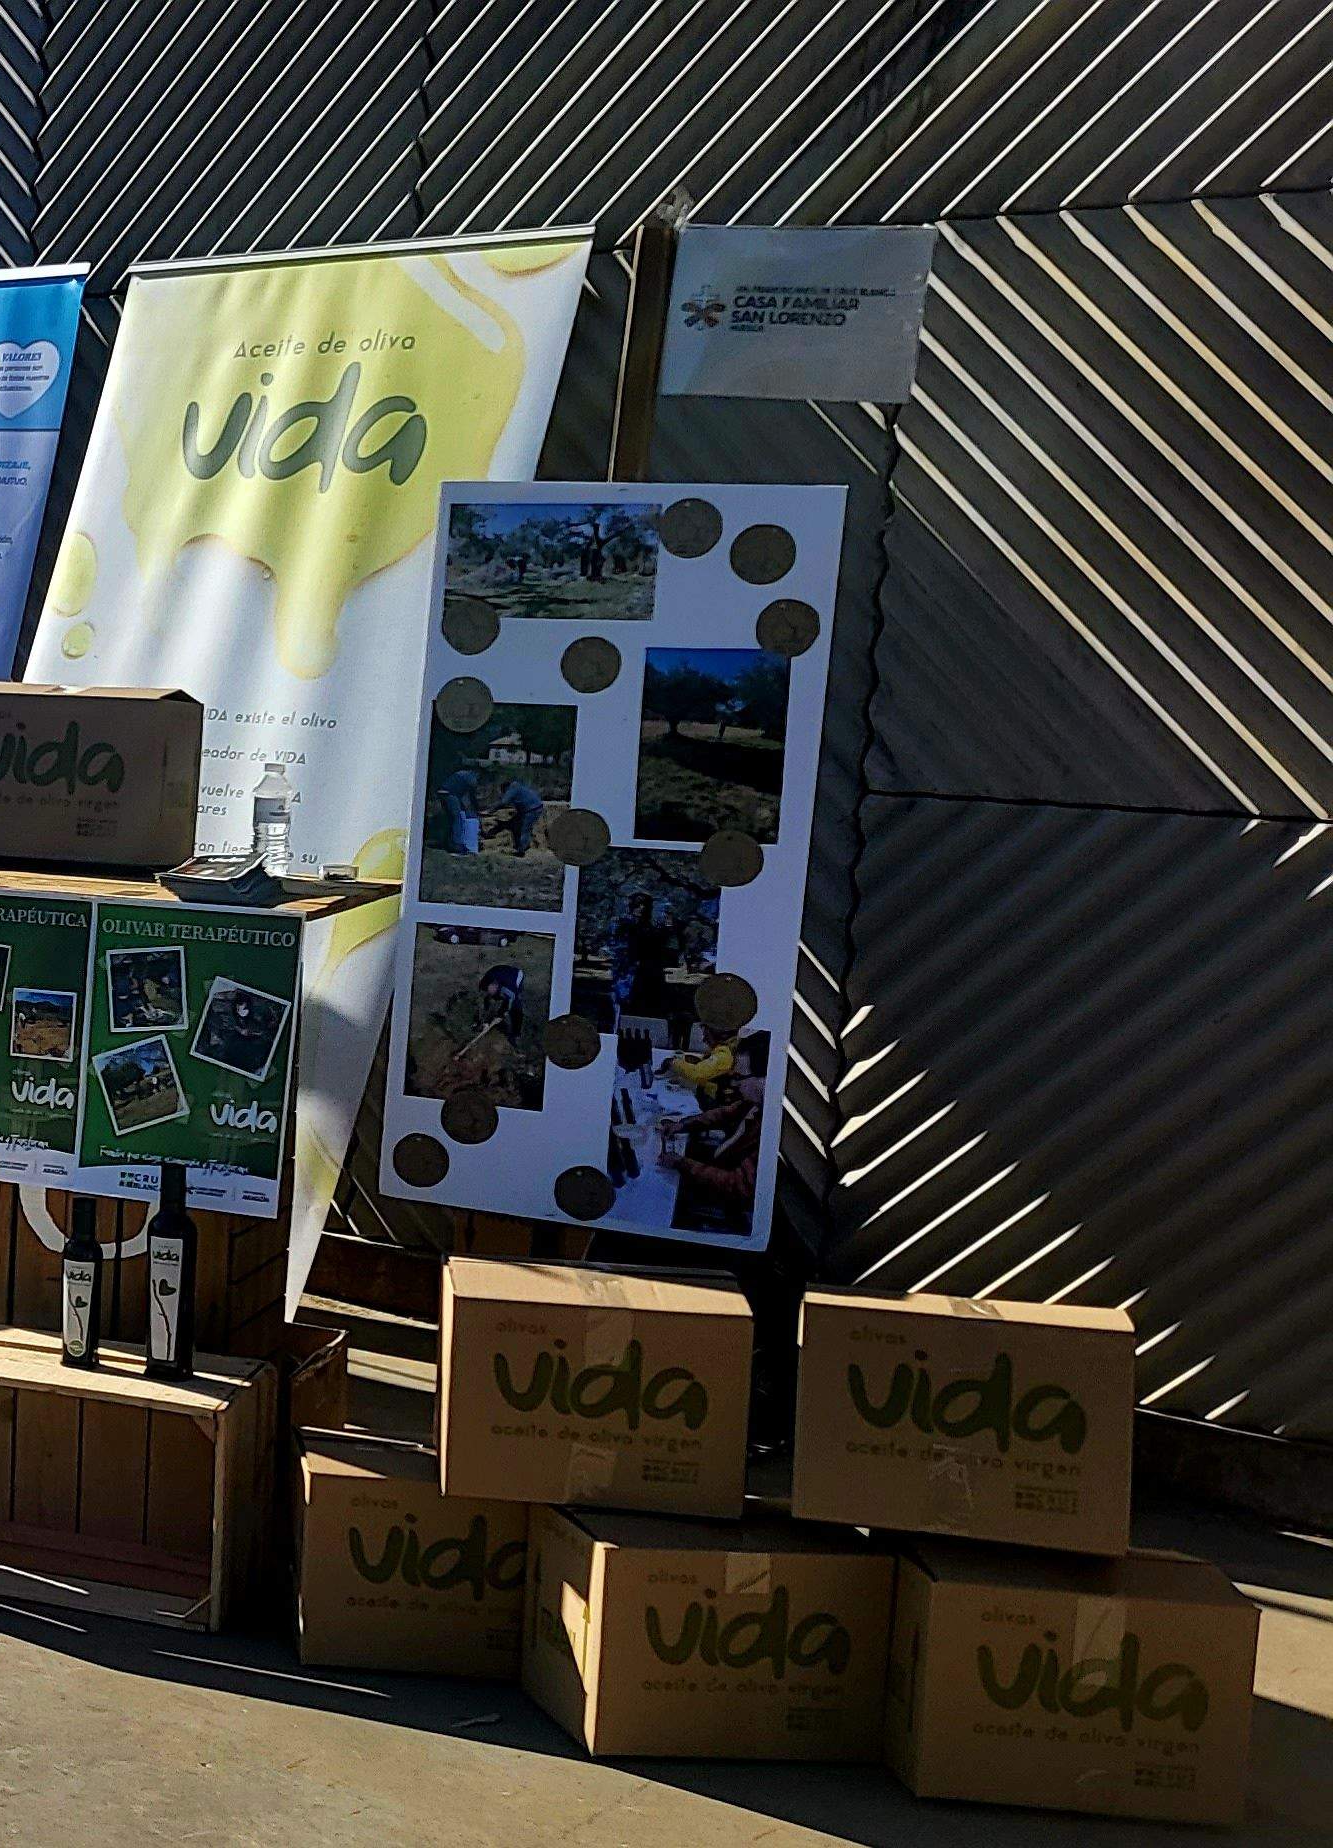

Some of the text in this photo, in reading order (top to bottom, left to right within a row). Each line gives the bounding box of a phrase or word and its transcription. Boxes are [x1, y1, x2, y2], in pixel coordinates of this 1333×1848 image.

[731, 310, 847, 326] SAN LORENZO
[734, 295, 860, 311] CASA FAMILIAR
[2, 352, 43, 363] VALORES
[234, 334, 306, 359] Aceite
[316, 331, 347, 356] de
[182, 361, 428, 494] vida
[235, 710, 338, 729] existe el olivo
[249, 748, 268, 762] de
[275, 751, 306, 765] VIDA
[102, 918, 295, 947] OLIVAR TERAPÉUTICO
[11, 1076, 74, 1110] vida
[210, 1098, 278, 1134] vida
[493, 1338, 709, 1431] vida
[847, 1350, 1087, 1456] vida
[491, 1424, 550, 1439] aceite
[558, 1425, 581, 1441] de
[349, 1513, 528, 1601] vida
[644, 1585, 851, 1680] vida
[977, 1630, 1209, 1733] vida
